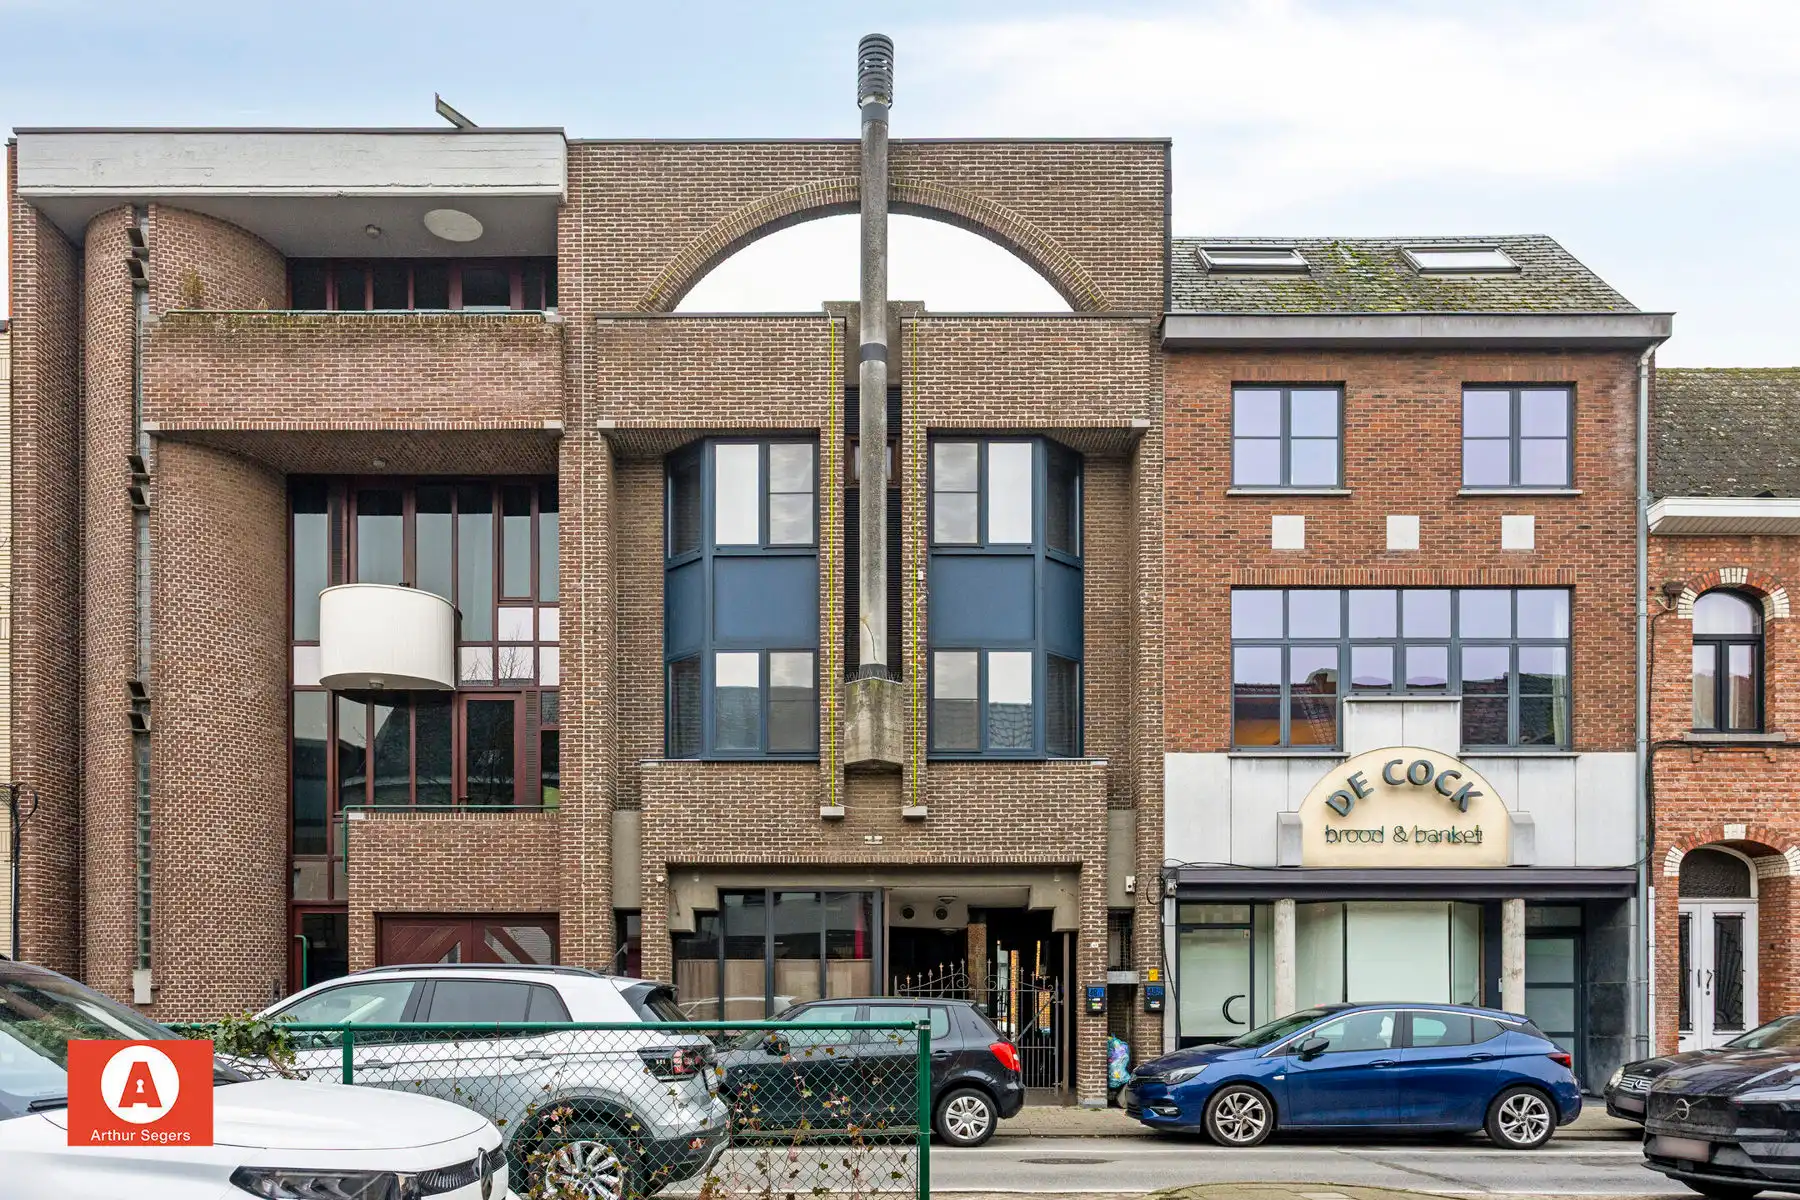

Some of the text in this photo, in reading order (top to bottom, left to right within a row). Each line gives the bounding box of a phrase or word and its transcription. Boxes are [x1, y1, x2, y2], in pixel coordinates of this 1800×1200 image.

[1325, 759, 1483, 817] DE COCK
[1325, 825, 1483, 844] brood & banket
